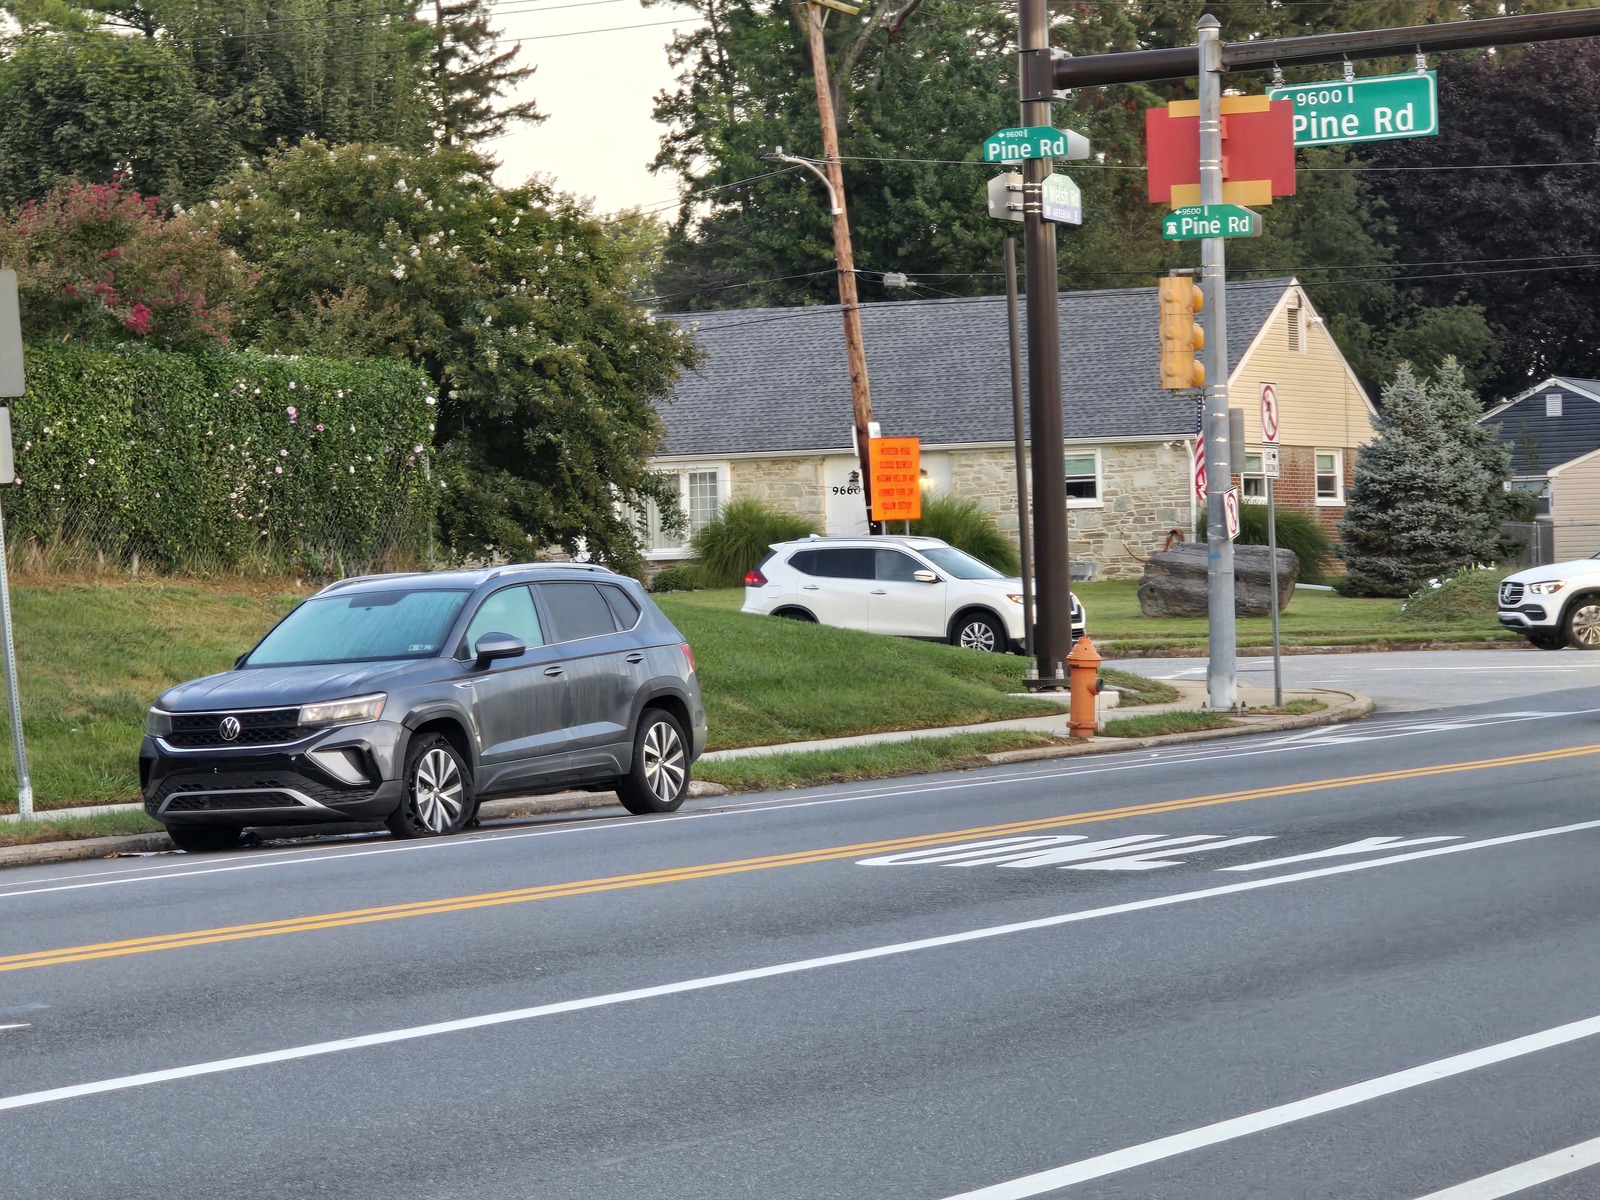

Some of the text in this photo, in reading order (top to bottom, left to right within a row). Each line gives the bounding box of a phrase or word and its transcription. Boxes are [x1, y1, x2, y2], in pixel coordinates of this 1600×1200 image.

[1296, 89, 1343, 106] 9600
[1293, 102, 1414, 141] Pine Rd
[988, 136, 1064, 160] Pine Rd
[1181, 215, 1249, 236] Pine Rd
[832, 485, 861, 496] 9660
[855, 834, 1466, 872] ONLY
